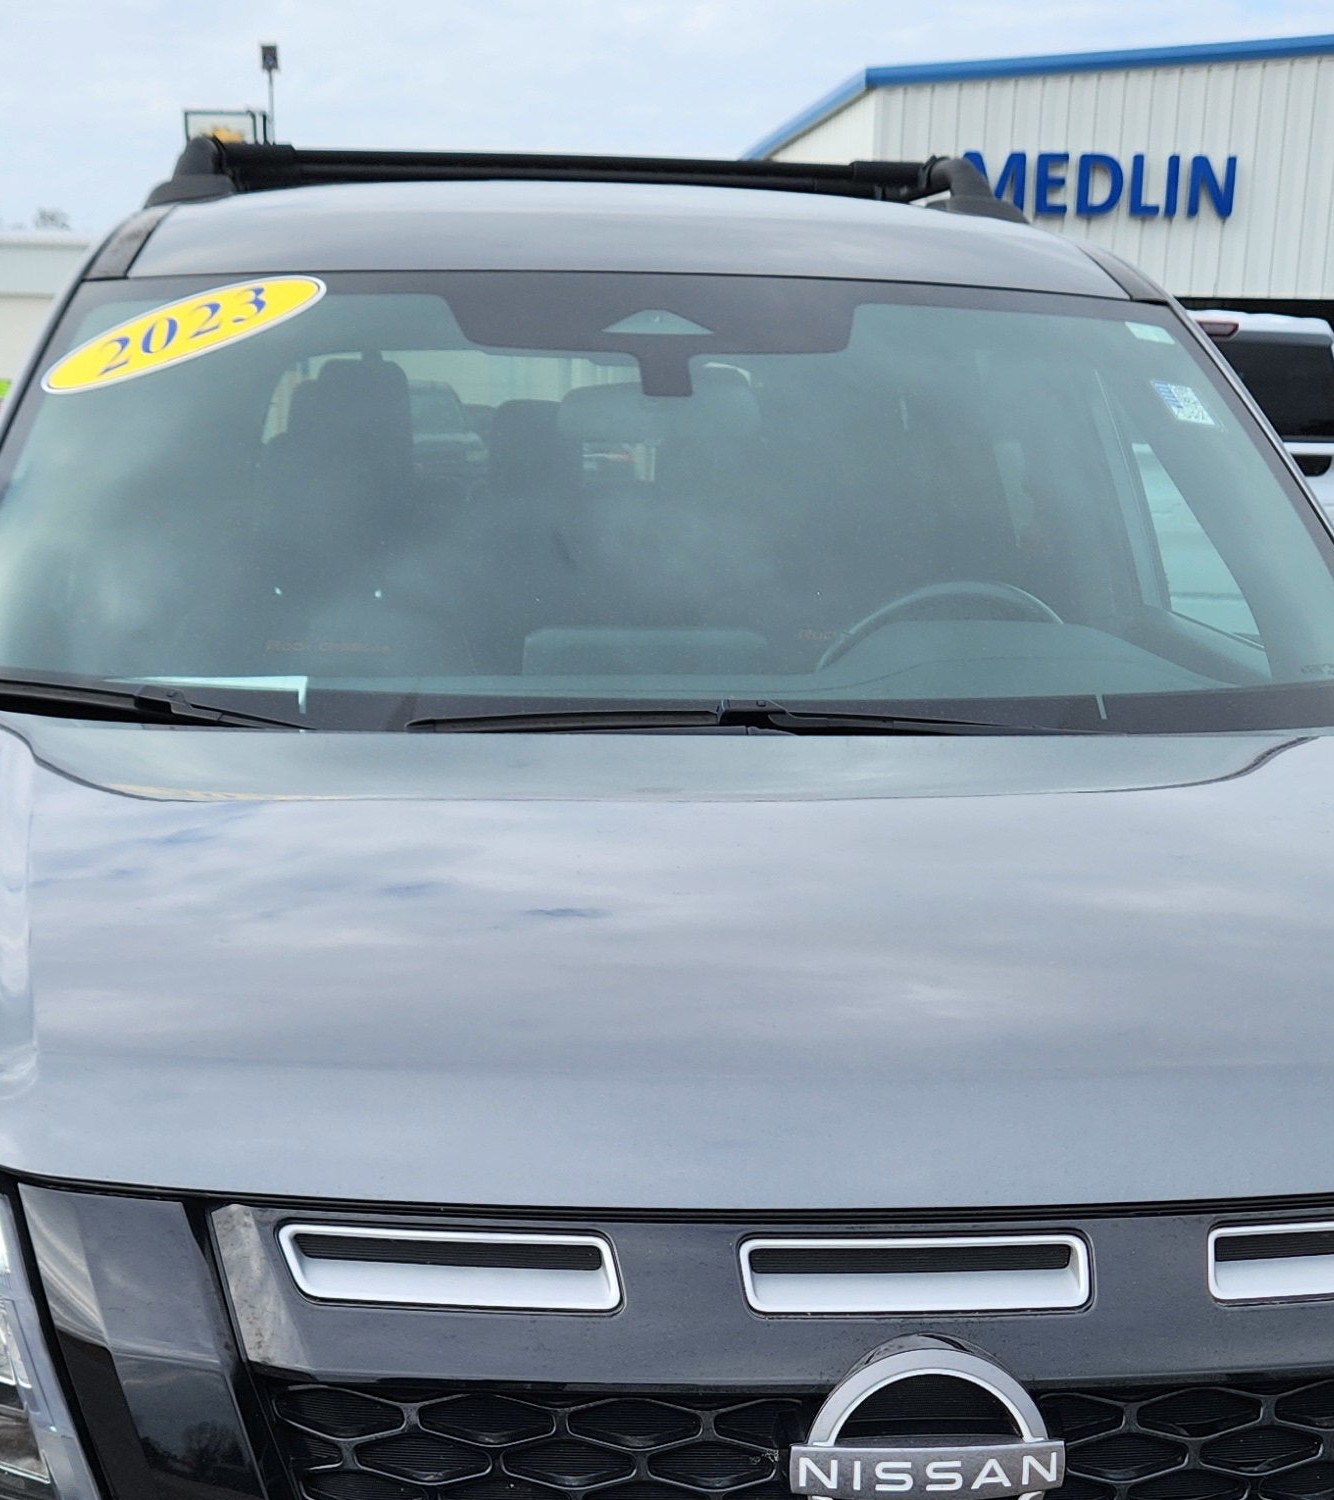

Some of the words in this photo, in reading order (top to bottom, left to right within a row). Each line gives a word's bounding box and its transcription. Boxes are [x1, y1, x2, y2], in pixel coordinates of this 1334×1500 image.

[962, 151, 1238, 219] MEDLIN
[97, 286, 267, 377] 2023
[798, 1451, 1058, 1492] NISSAN
